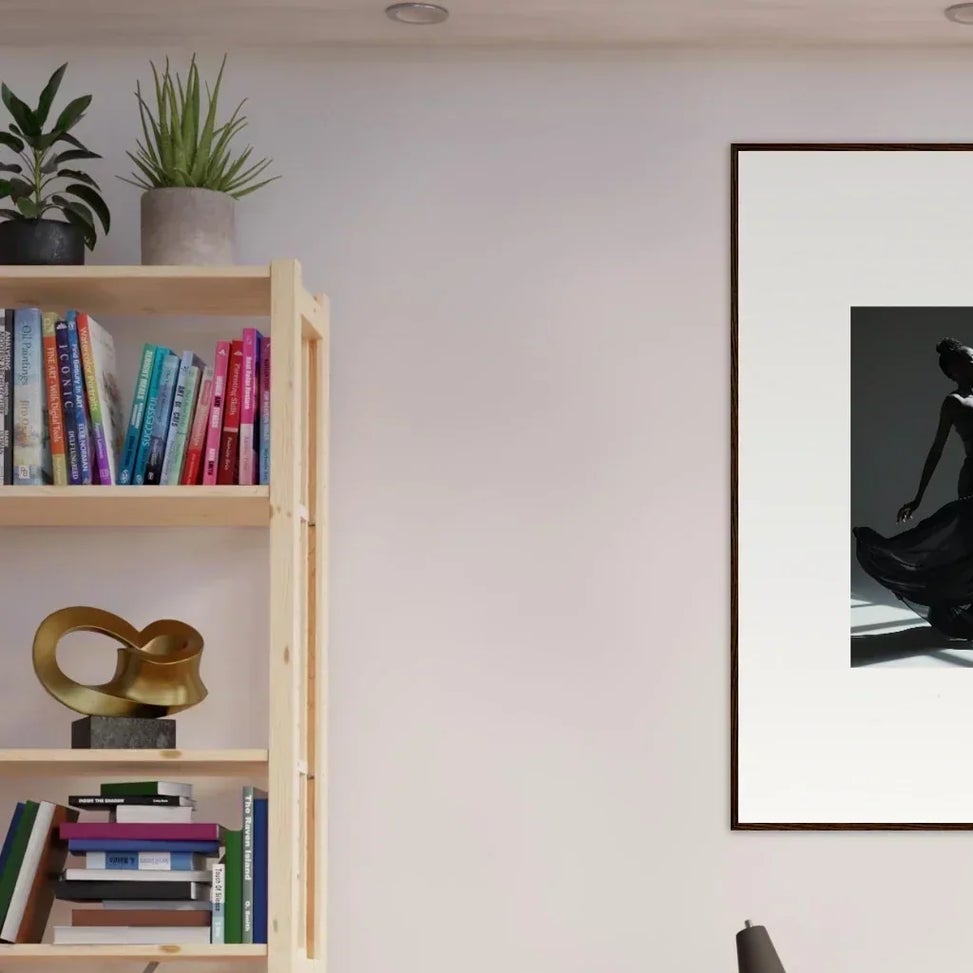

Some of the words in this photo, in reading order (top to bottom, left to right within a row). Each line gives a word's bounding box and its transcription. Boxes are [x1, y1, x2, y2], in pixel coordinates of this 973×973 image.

[22, 325, 31, 338] Oil
[47, 347, 55, 362] FINE
[71, 343, 79, 358] Find
[19, 342, 31, 385] Paintings
[72, 359, 81, 384] Beauty
[79, 327, 93, 373] Watercolor
[86, 375, 99, 411] Portraits
[229, 362, 240, 396] Parenting
[49, 383, 59, 401] With
[75, 394, 83, 408] ART
[50, 402, 61, 424] Digital
[229, 397, 237, 415] Skills
[141, 395, 157, 446] SUCCESSFUL
[53, 425, 62, 441] Tools
